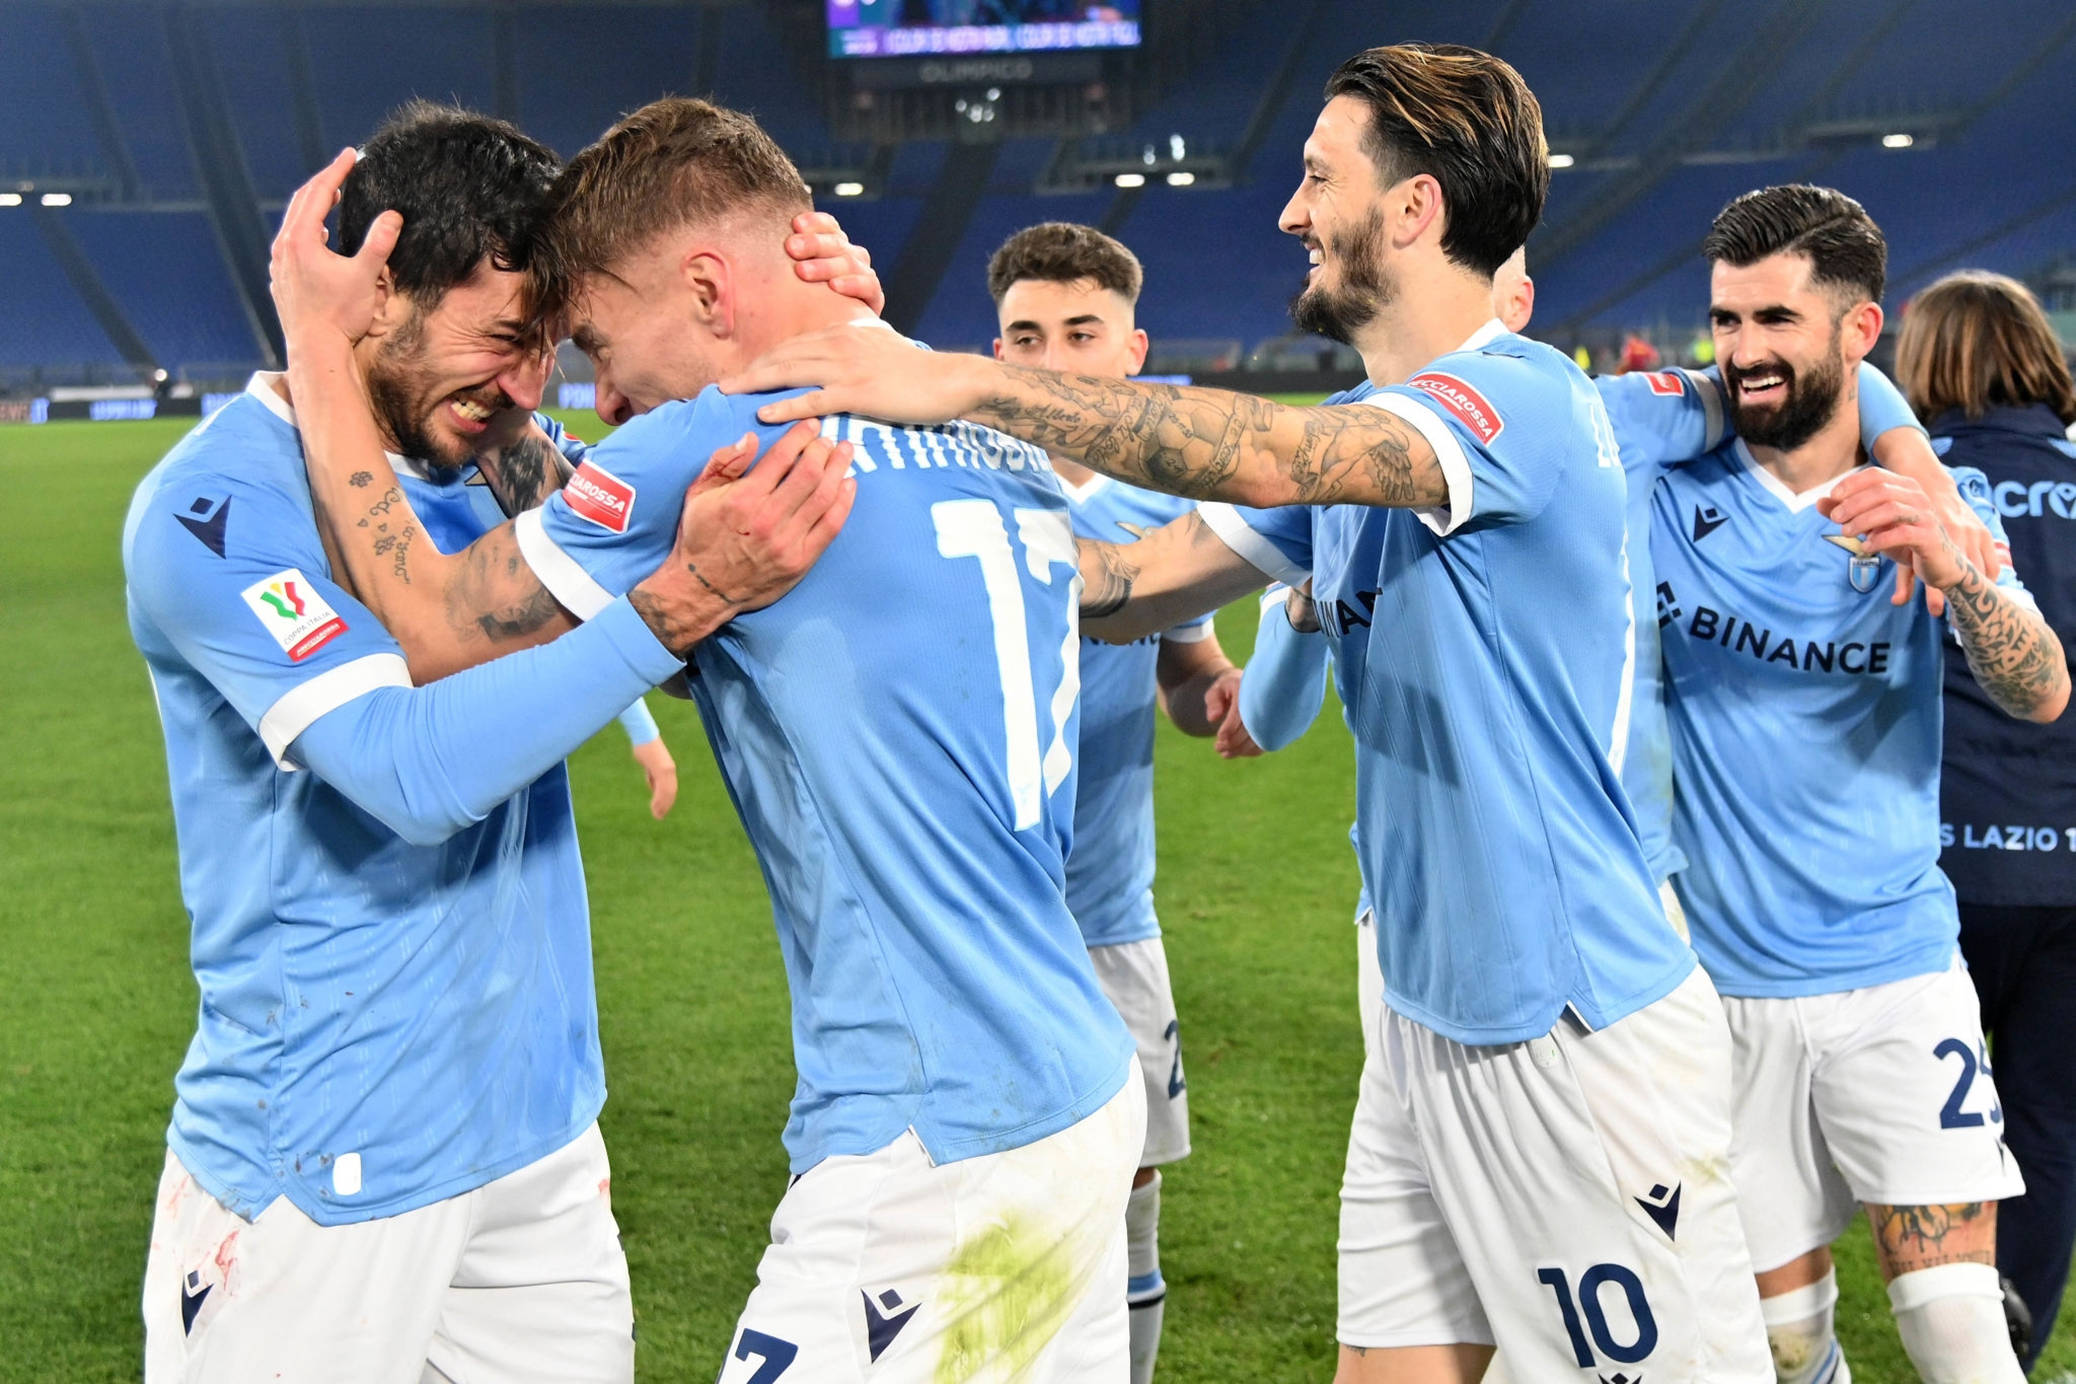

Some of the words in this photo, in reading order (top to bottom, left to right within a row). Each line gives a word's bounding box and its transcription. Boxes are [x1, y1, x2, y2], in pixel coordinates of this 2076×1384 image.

[1689, 606, 1891, 674] BINANCE
[1963, 824, 2059, 852] LAZIO
[1537, 1262, 1659, 1369] 10
